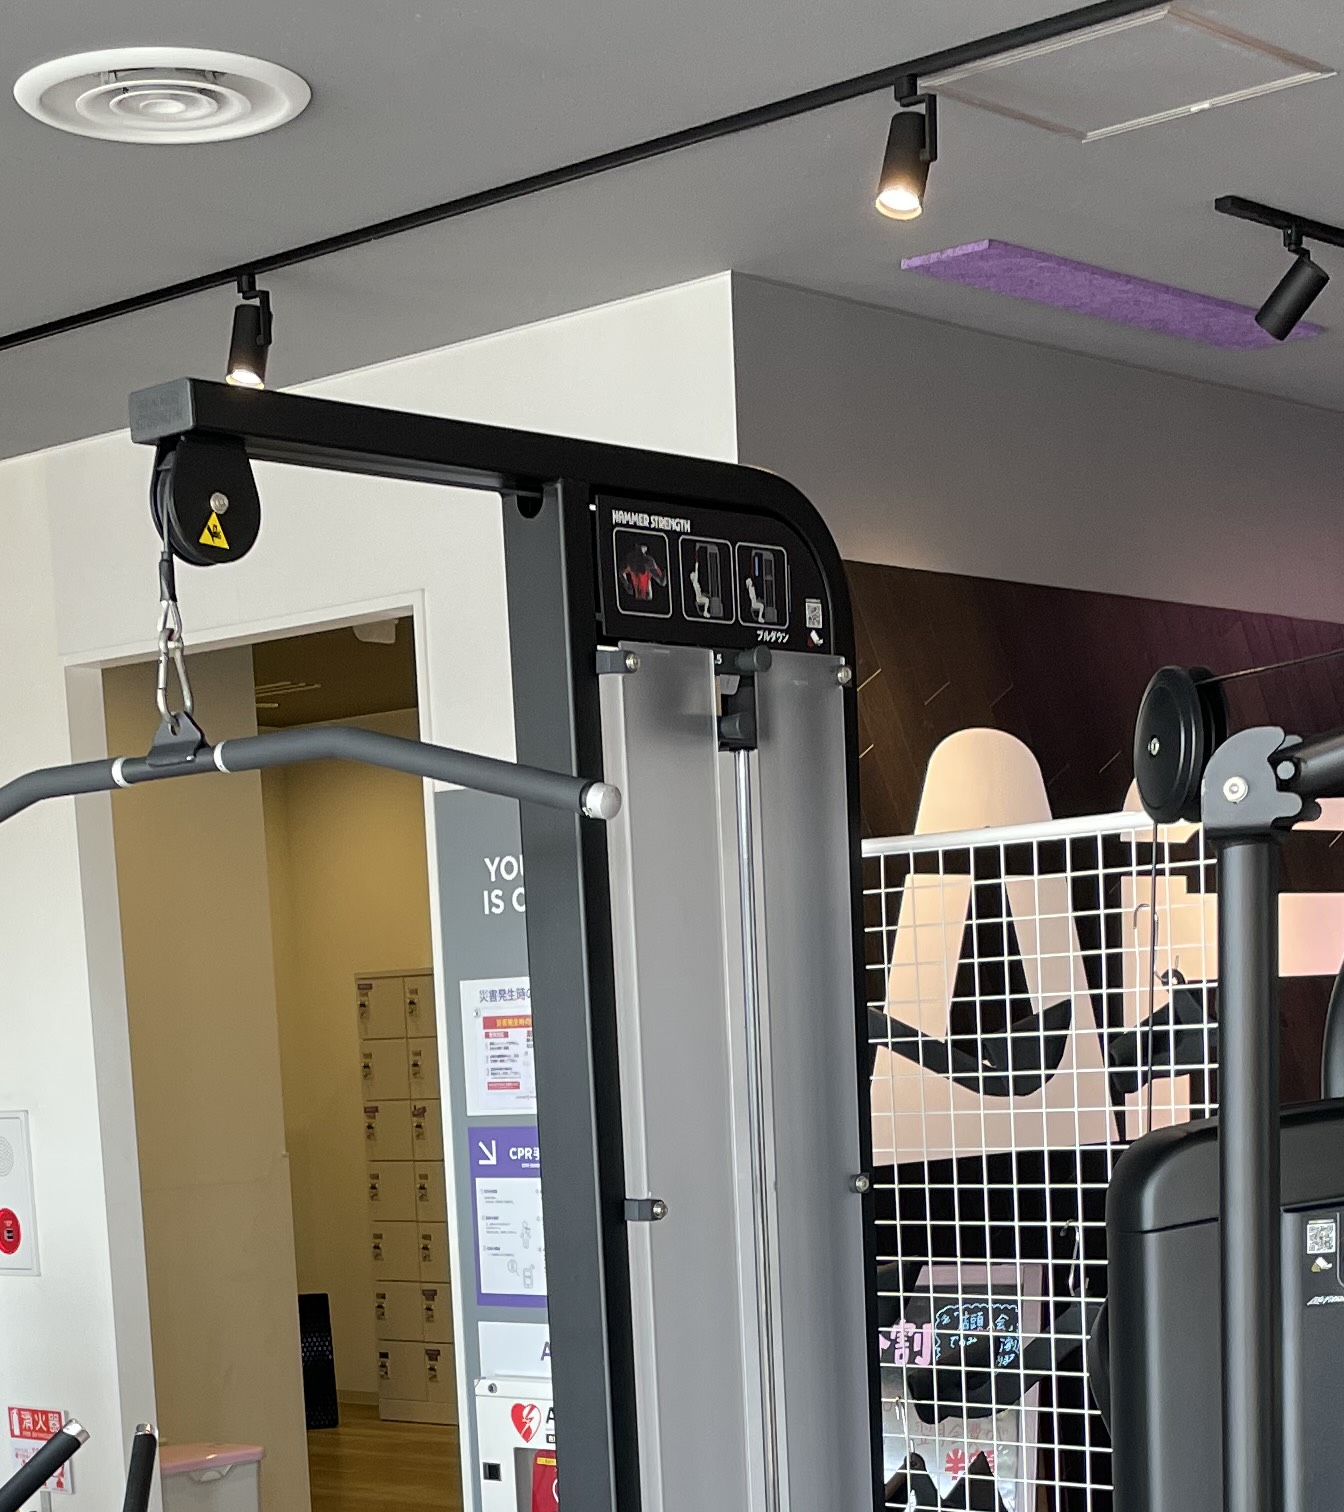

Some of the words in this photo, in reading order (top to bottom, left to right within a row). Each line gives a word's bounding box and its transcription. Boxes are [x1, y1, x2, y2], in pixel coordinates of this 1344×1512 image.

[612, 510, 649, 527] HAMMER
[650, 515, 691, 533] STRENGTH
[483, 889, 505, 915] IS
[20, 1410, 60, 1433] 消火器
